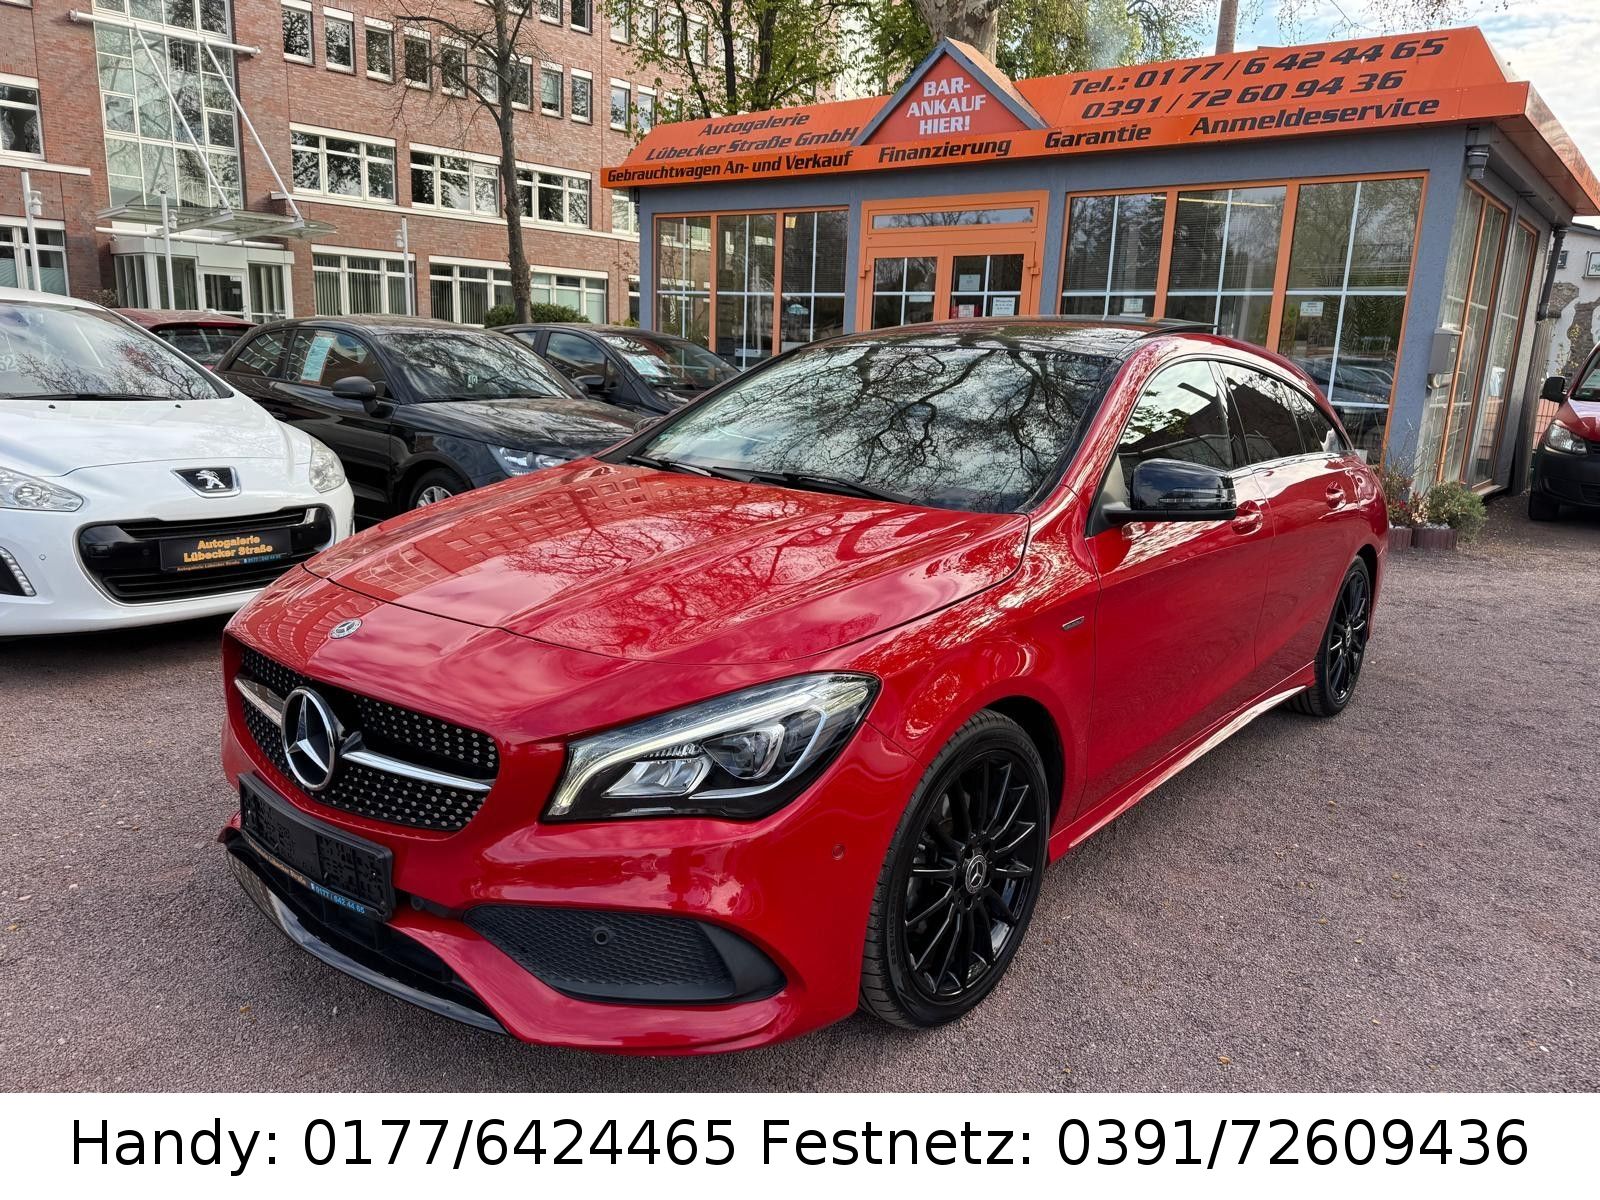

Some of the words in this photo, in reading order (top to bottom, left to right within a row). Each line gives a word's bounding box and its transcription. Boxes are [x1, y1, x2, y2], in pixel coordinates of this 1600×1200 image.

[1069, 75, 1130, 96] Tel.:
[1133, 61, 1225, 89] 0177
[1242, 56, 1270, 75] 6
[1272, 50, 1326, 71] 42
[1329, 43, 1385, 65] 44
[1390, 37, 1449, 60] 65
[923, 76, 971, 98] BAR-
[1081, 95, 1163, 119] 0391
[1186, 88, 1233, 109] 72
[1236, 82, 1288, 104] 60
[1290, 76, 1345, 99] 94
[1349, 69, 1407, 93] 36
[906, 94, 986, 118] ANKAUF
[1189, 97, 1440, 137] Anmeldeservice
[697, 112, 810, 137] Autogalerie
[919, 115, 970, 136] HIER!
[1044, 123, 1152, 150] Garantie
[645, 143, 727, 161] Lübecker
[726, 135, 793, 153] Straße
[794, 126, 860, 147] GmbH
[878, 138, 1012, 163] Finanzierung
[607, 163, 721, 182] Gebrauchtwagen
[723, 160, 749, 175] An-
[751, 155, 783, 173] und
[785, 150, 854, 171] Verkauf
[183, 548, 236, 563] Lübecker
[238, 544, 273, 556] Straße
[197, 535, 261, 550] Autogalerie
